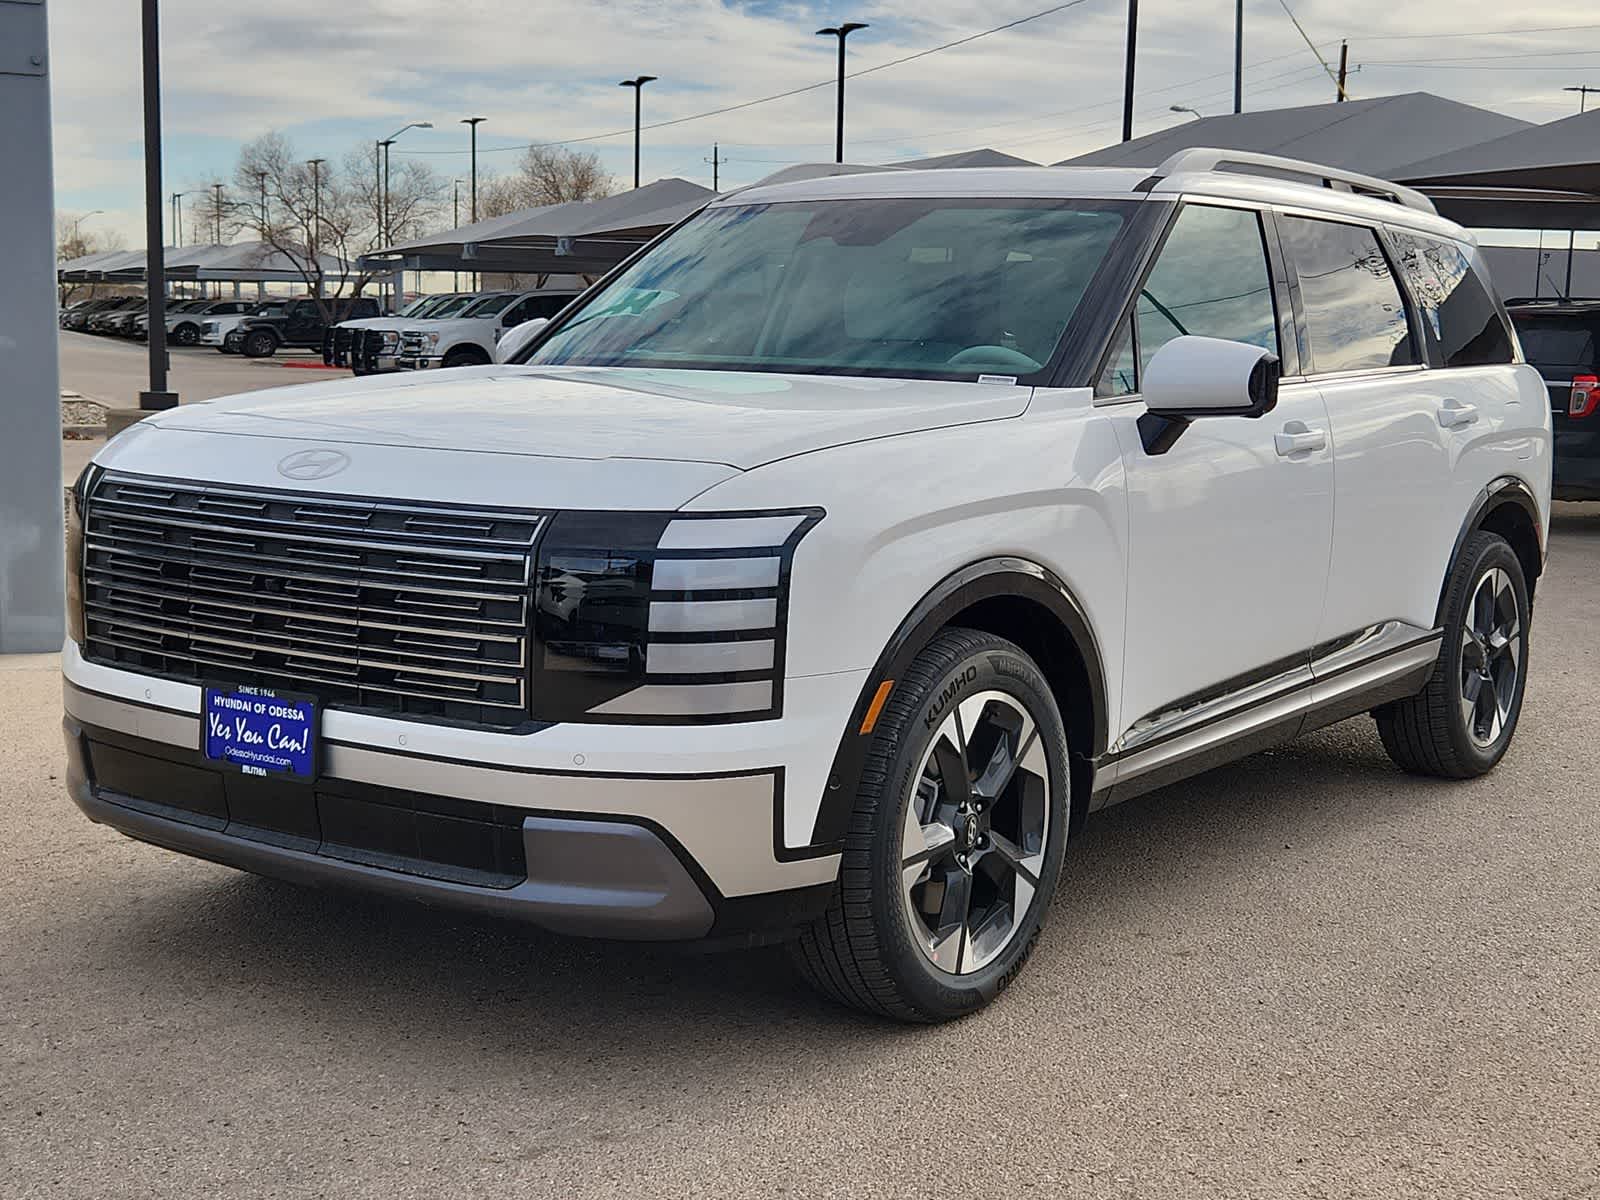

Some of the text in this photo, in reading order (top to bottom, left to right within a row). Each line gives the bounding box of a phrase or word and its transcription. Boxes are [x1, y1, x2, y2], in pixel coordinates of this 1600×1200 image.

[238, 685, 275, 698] SINCE 1946
[924, 665, 977, 730] KUMHO
[214, 695, 304, 721] HYUNDAI OF ODESSA
[209, 712, 309, 754] Yes You Can!
[224, 745, 292, 766] OdessaHyundai.com
